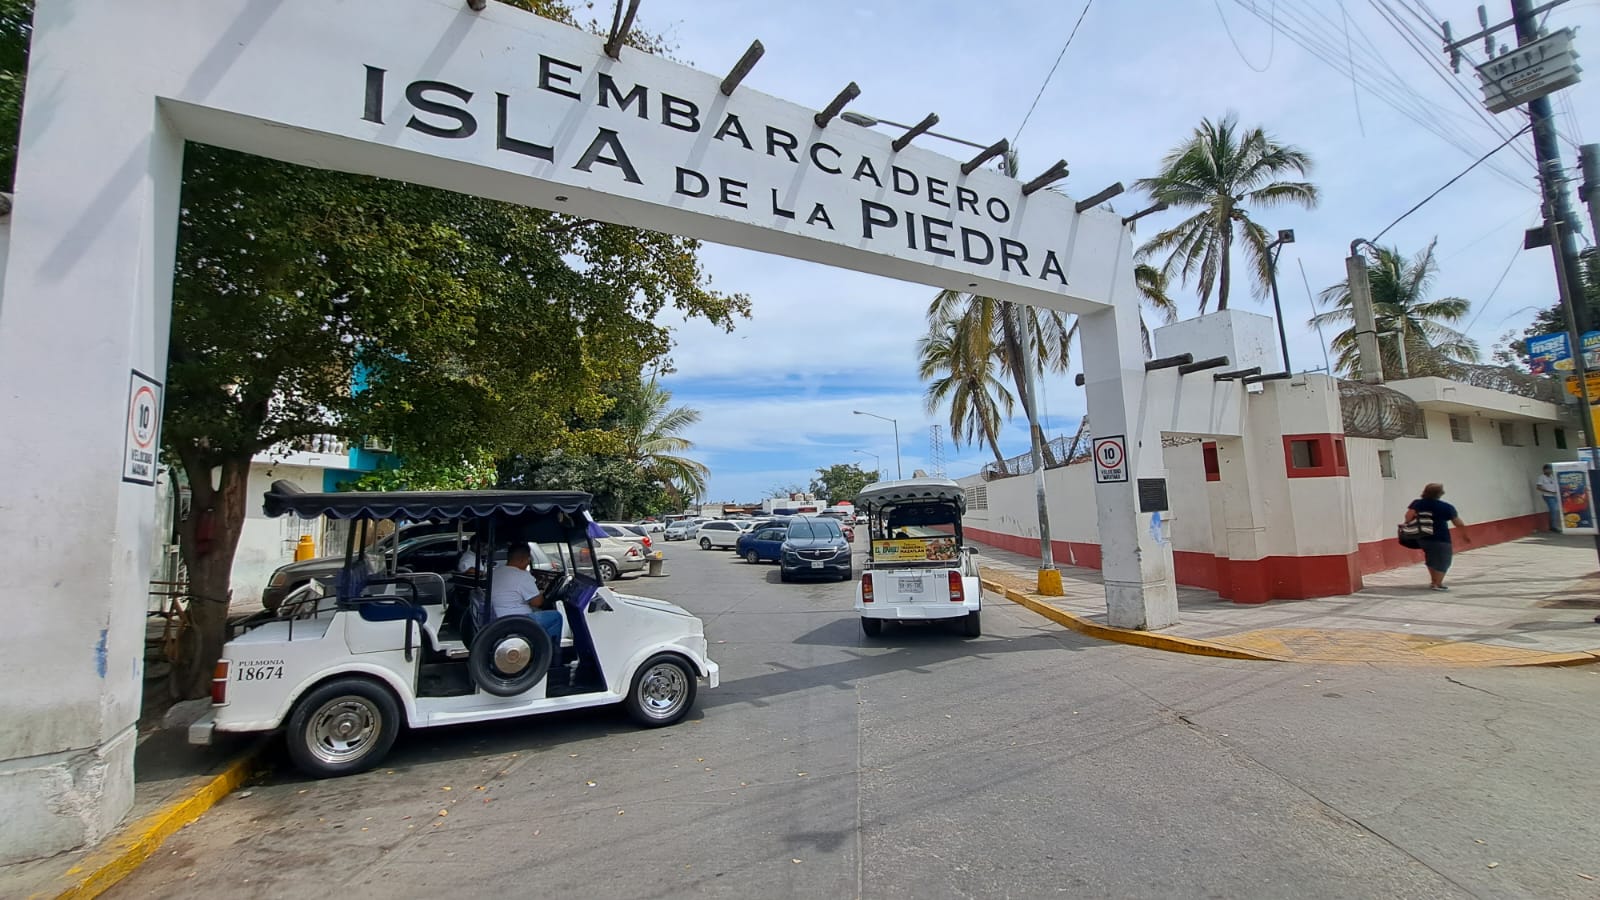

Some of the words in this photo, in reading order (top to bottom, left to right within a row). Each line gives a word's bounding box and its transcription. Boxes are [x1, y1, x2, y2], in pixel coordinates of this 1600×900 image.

[537, 54, 1011, 223] EMBARCADERO
[360, 63, 644, 186] ISLA
[674, 165, 749, 209] DE
[771, 187, 836, 230] LA
[859, 198, 1069, 286] PIEDRA
[139, 404, 150, 429] 10
[1104, 447, 1115, 460] 10
[239, 659, 285, 667] PULMONIA
[237, 666, 283, 681] 18674
